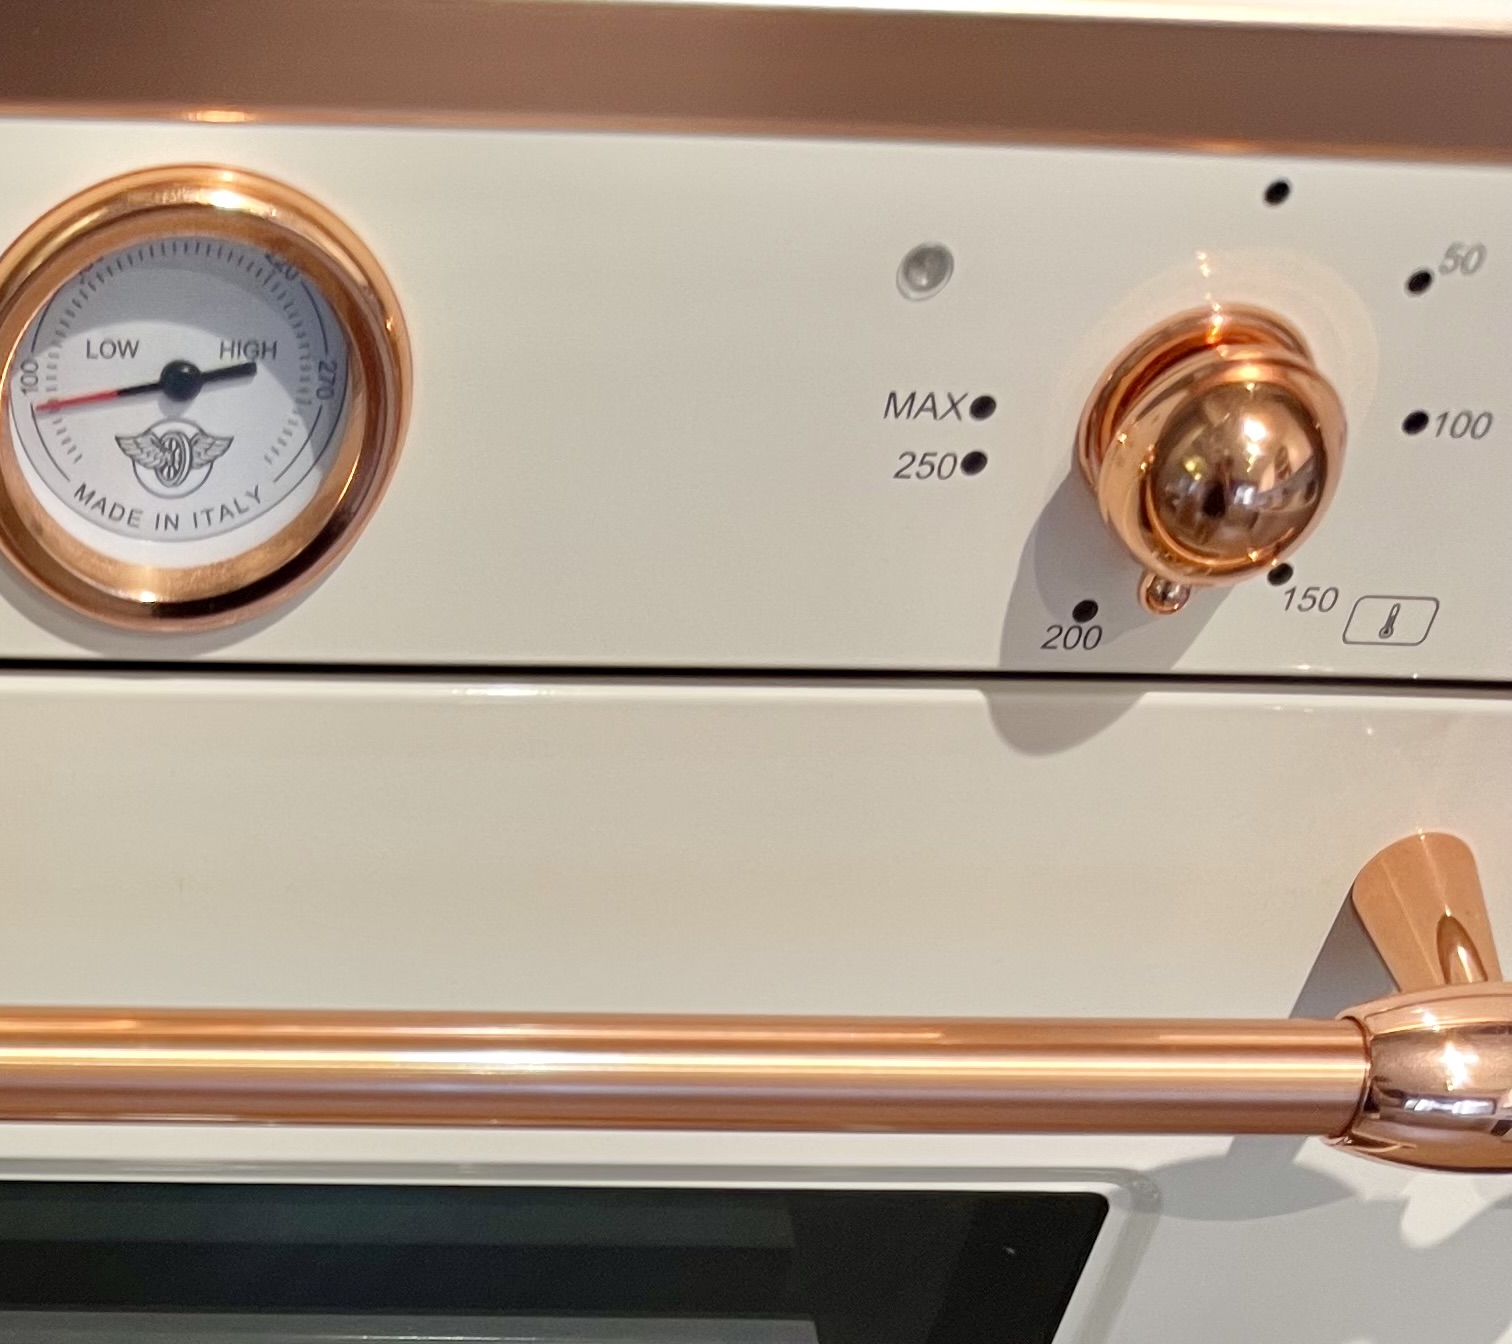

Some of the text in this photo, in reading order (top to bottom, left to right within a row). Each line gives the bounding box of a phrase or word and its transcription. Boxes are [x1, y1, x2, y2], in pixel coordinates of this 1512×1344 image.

[1437, 241, 1487, 276] 50
[85, 339, 278, 361] LOW HIGH
[20, 359, 39, 397] 100
[316, 360, 338, 400] 270
[883, 391, 970, 422] MAX
[1433, 411, 1494, 440] 100
[893, 452, 957, 480] 250
[73, 482, 264, 531] MADE IN ITALY
[1283, 586, 1339, 614] 150
[1041, 624, 1103, 652] 200
